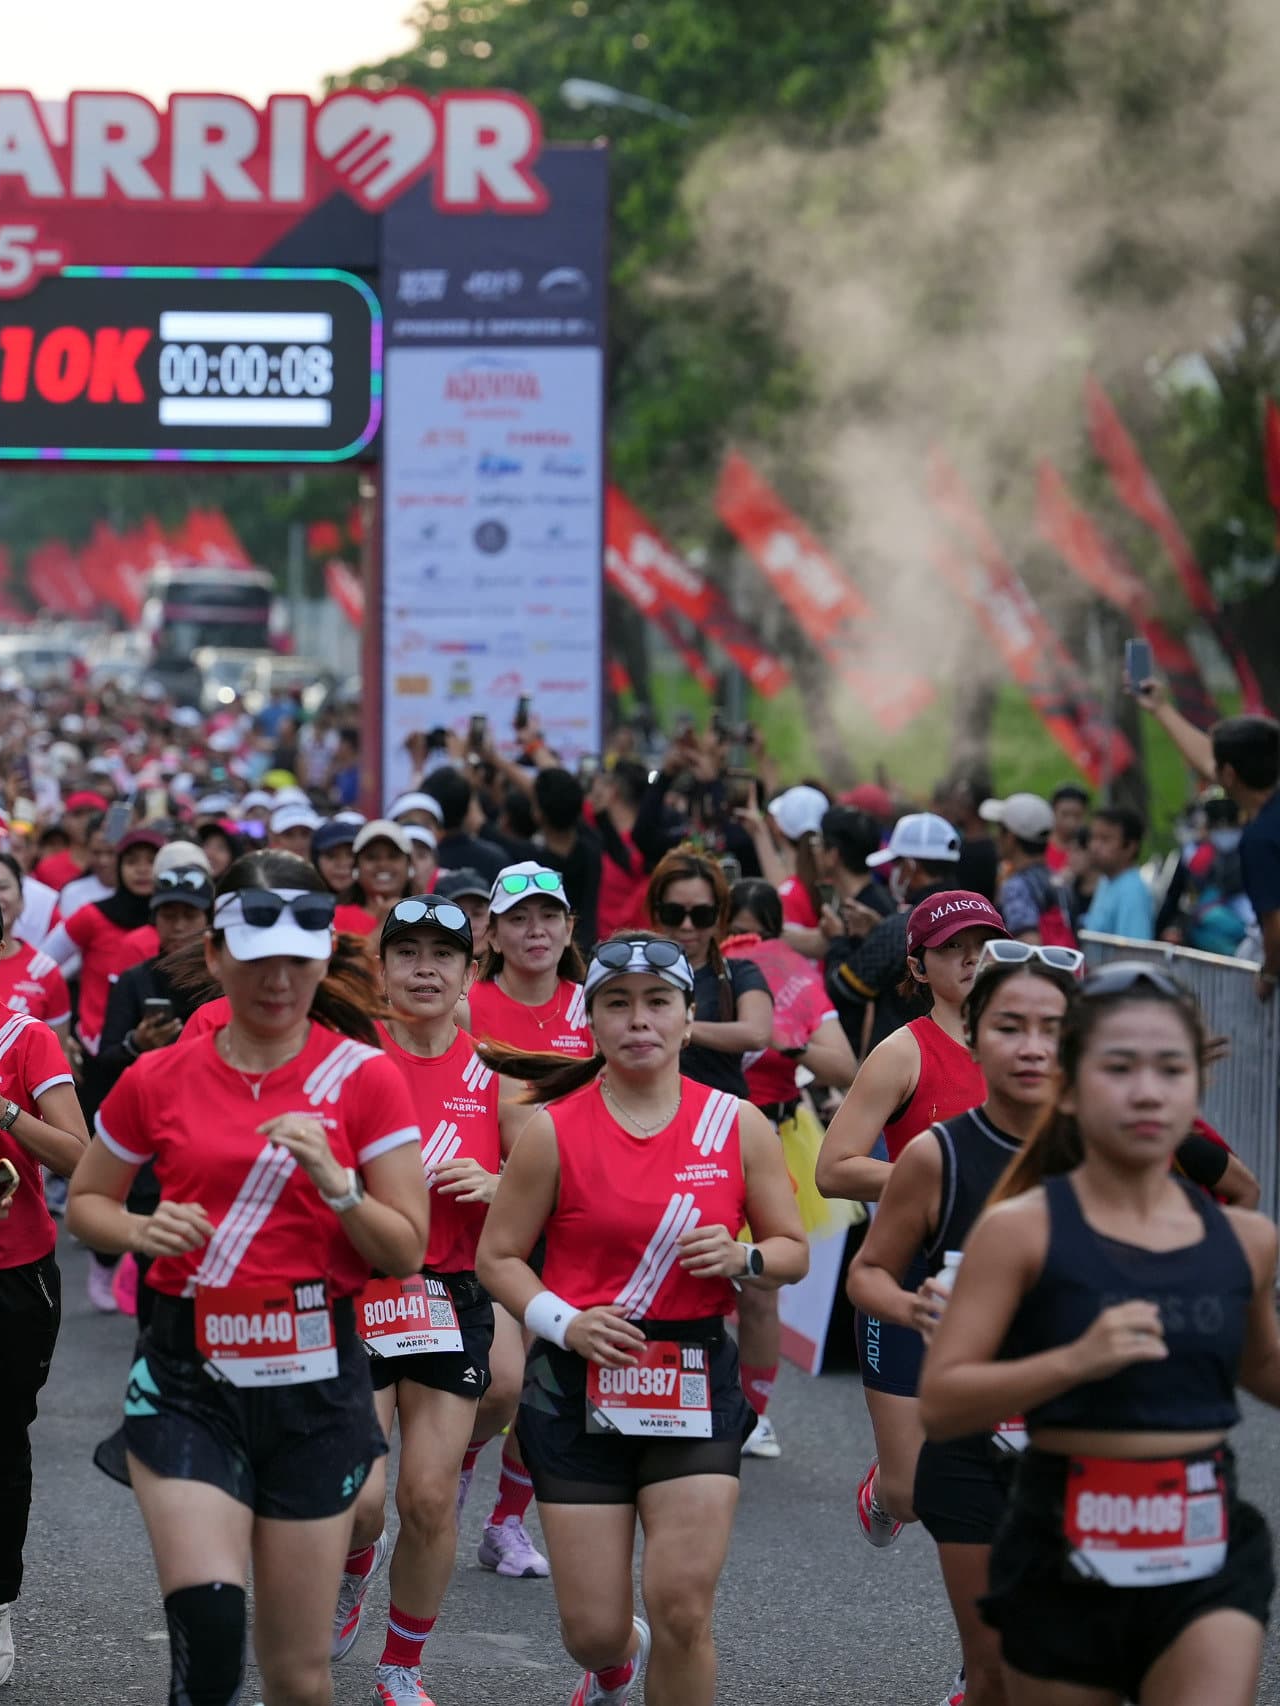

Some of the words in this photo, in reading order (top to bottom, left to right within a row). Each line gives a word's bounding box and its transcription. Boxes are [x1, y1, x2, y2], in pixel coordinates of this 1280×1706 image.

[0, 326, 152, 404] 10K
[158, 344, 334, 395] 00:00:08
[929, 900, 993, 922] MAISON
[294, 1283, 326, 1311] 10K
[424, 1278, 448, 1298] 10K
[363, 1295, 427, 1327] 800441
[204, 1311, 293, 1346] 800440
[681, 1347, 705, 1370] 10K
[867, 1314, 881, 1375] ADIZE
[598, 1366, 678, 1397] 800387
